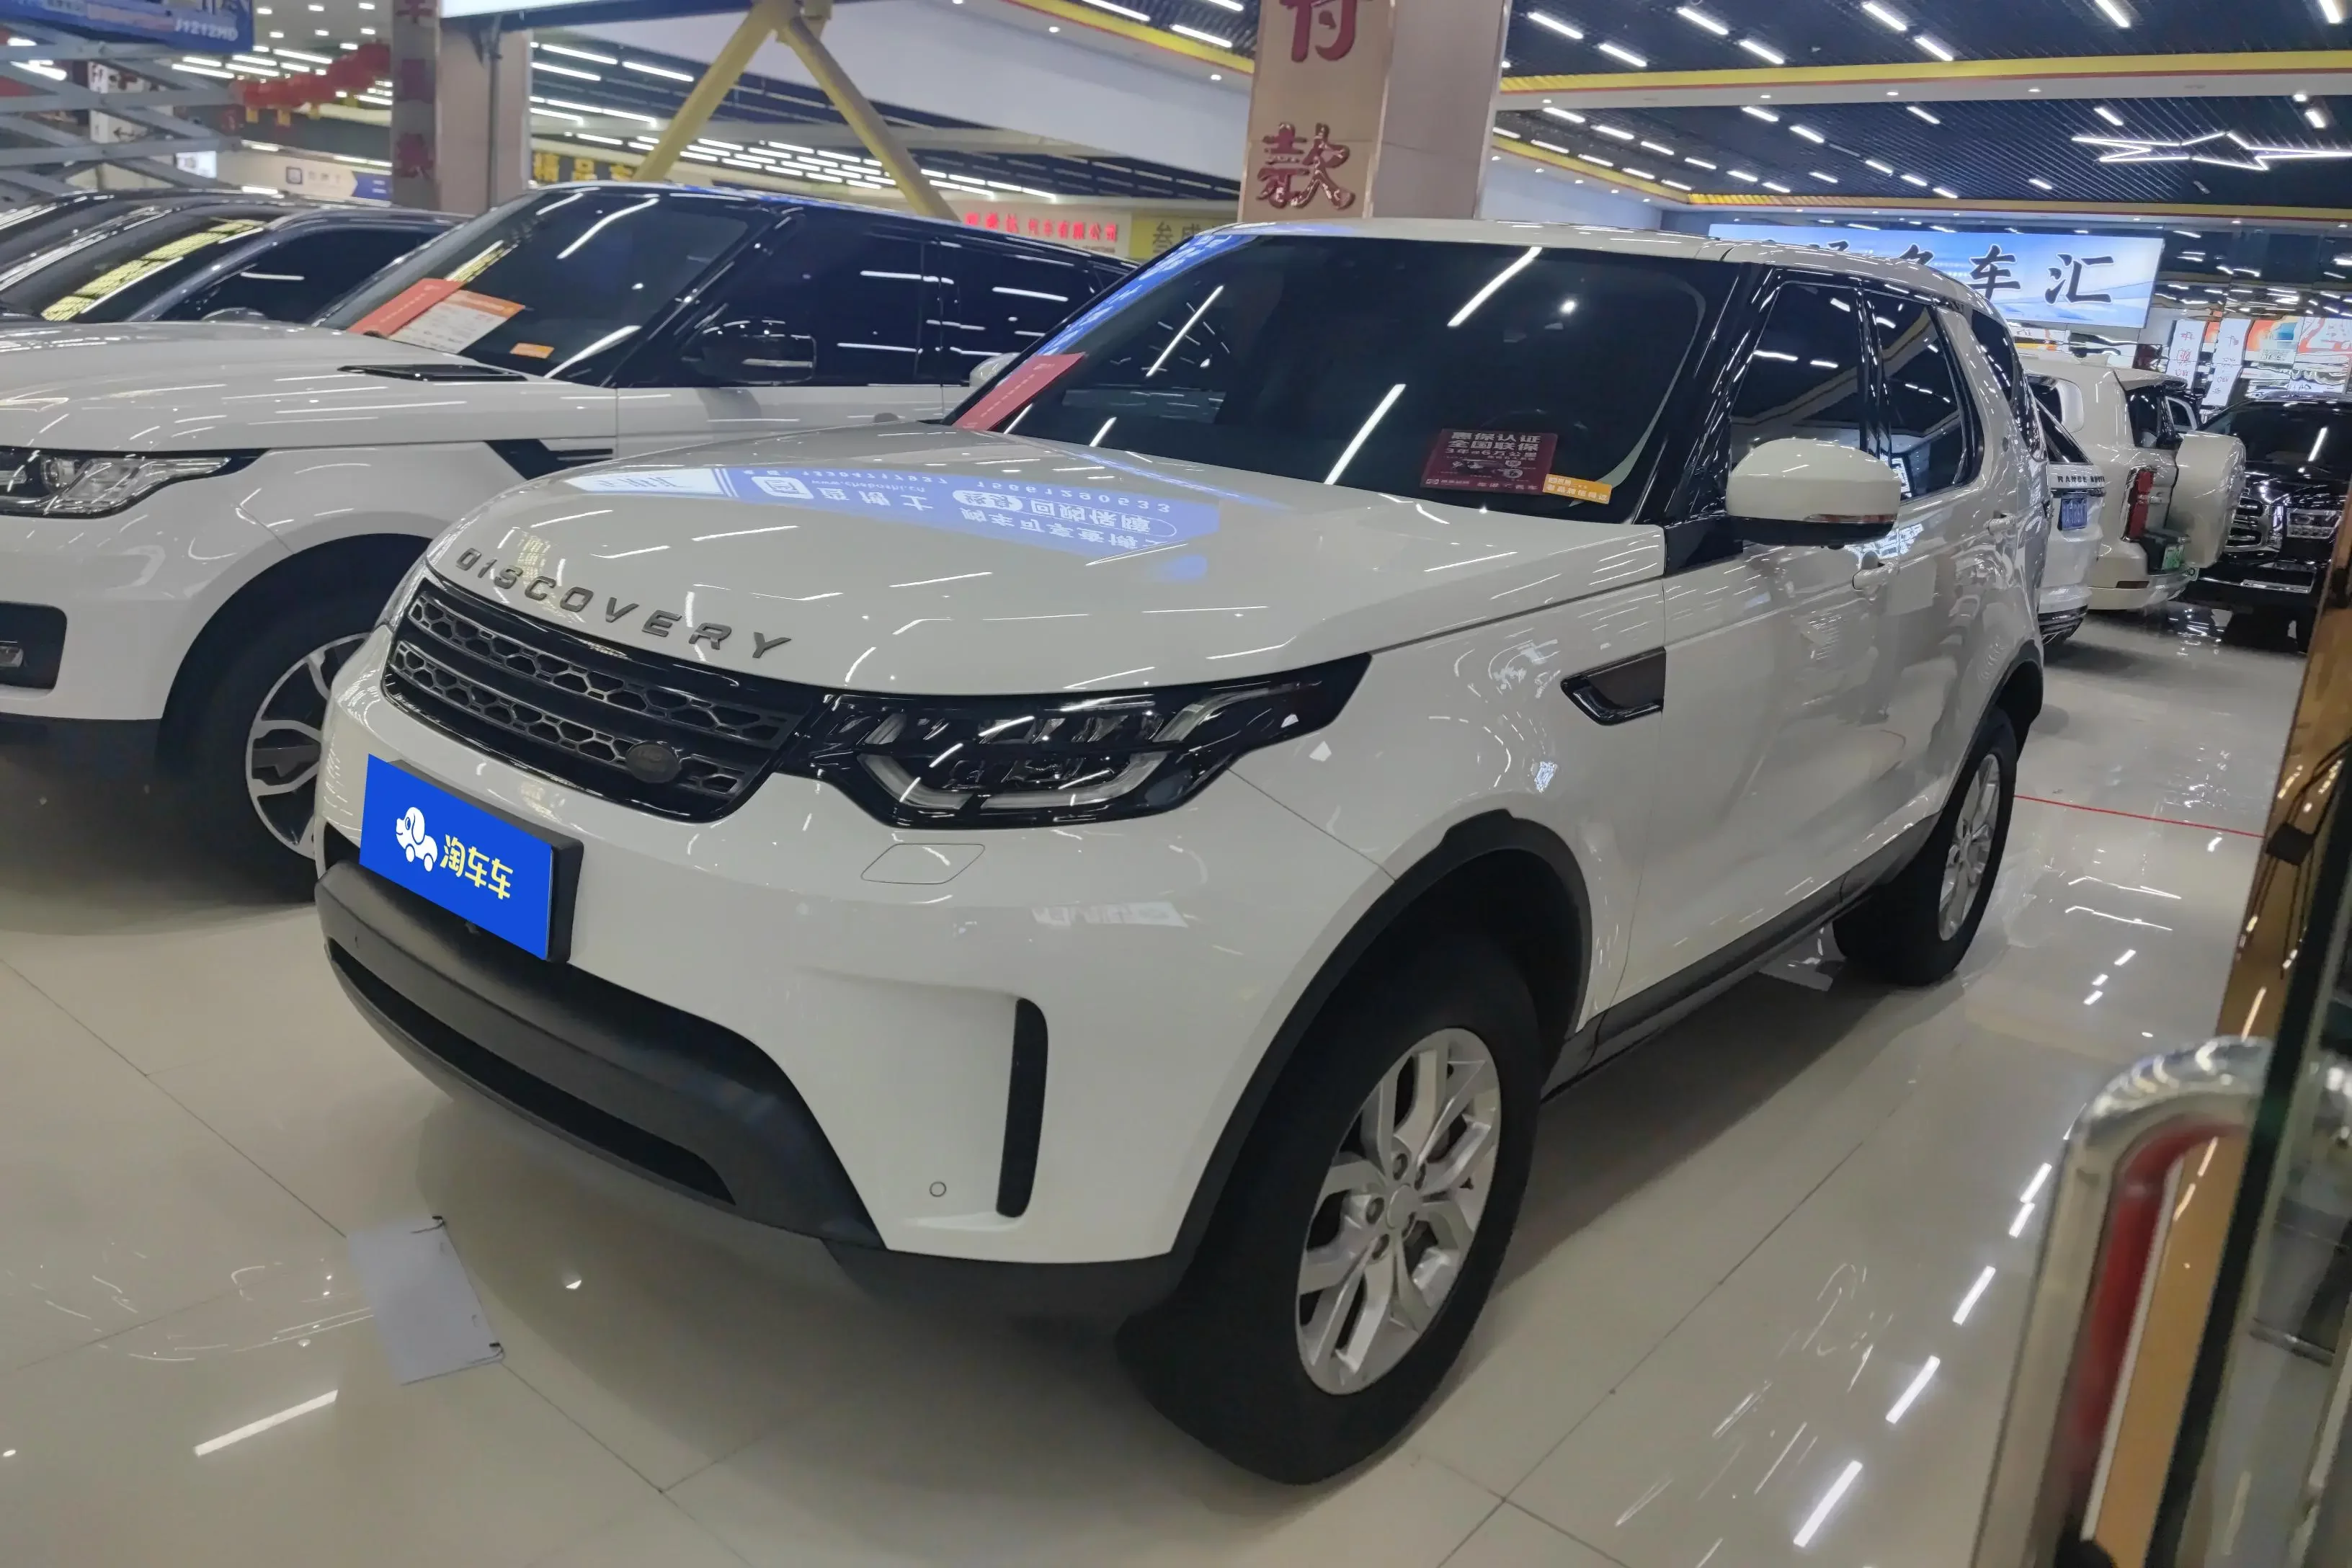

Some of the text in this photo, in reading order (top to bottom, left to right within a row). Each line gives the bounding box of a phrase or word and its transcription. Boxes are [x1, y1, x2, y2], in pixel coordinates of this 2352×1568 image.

[1448, 440, 1538, 451] 全国联保
[455, 548, 791, 659] DISCOVERY
